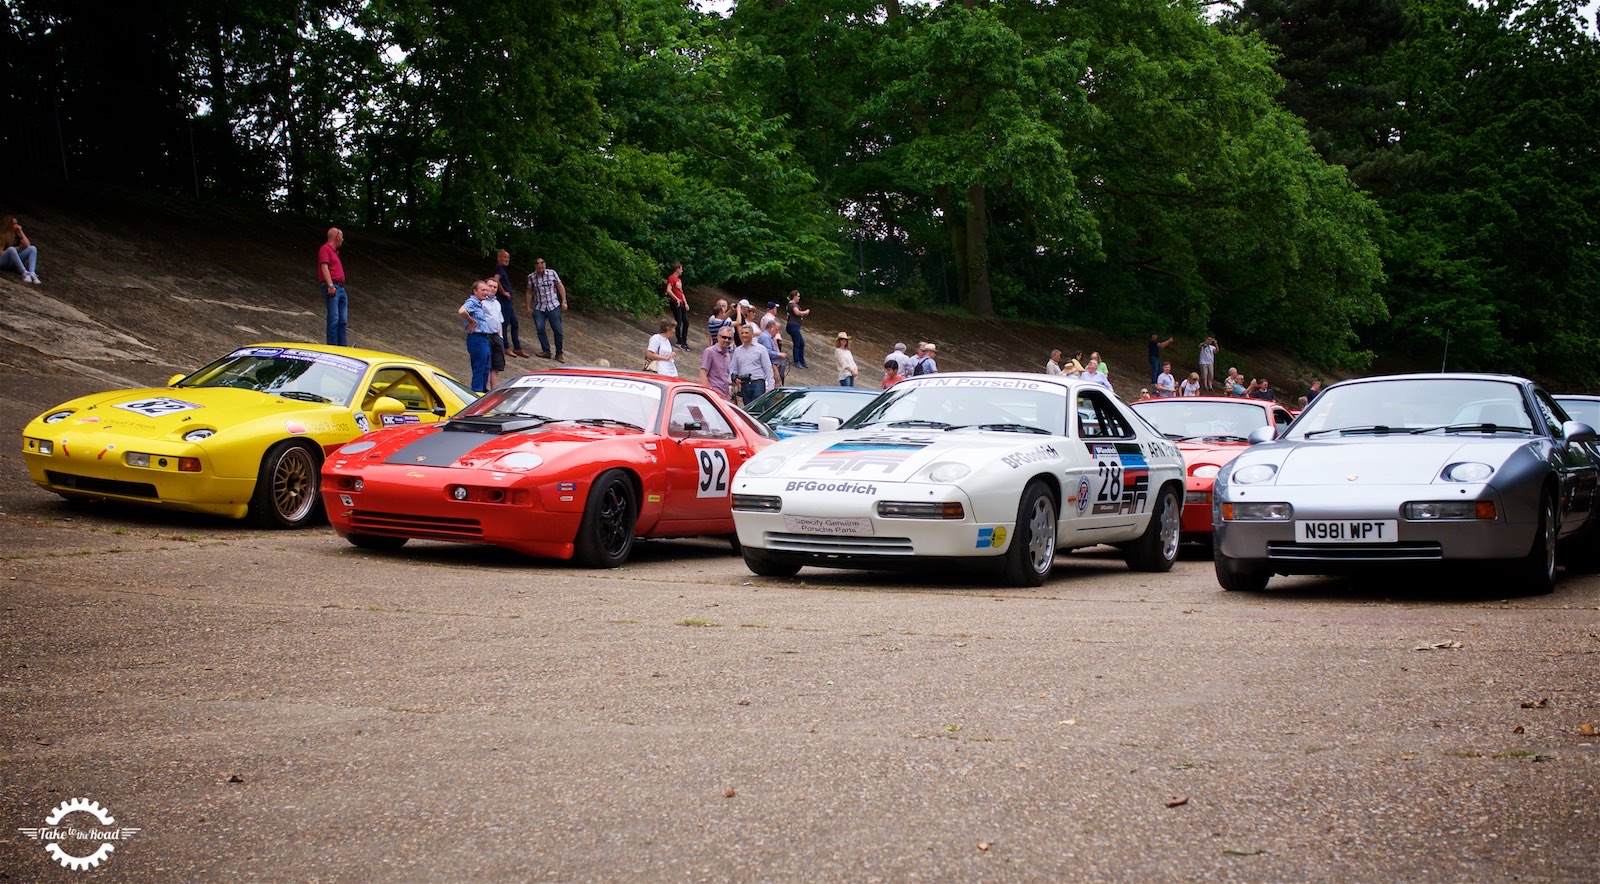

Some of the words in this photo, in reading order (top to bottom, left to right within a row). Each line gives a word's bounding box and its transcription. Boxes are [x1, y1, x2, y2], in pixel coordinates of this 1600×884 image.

[524, 377, 646, 391] PARAGON
[910, 378, 951, 388] AFN
[955, 378, 1040, 390] Porsche
[1001, 445, 1060, 469] BFGoodrich
[1147, 442, 1168, 458] AFN
[700, 450, 727, 492] 92
[785, 481, 877, 495] BFGoodrich
[1097, 461, 1121, 502] 28
[795, 518, 824, 528] Specify
[825, 519, 860, 527] Genuine
[801, 525, 834, 534] Porsche
[1305, 523, 1344, 539] N981
[1350, 522, 1385, 539] WPT
